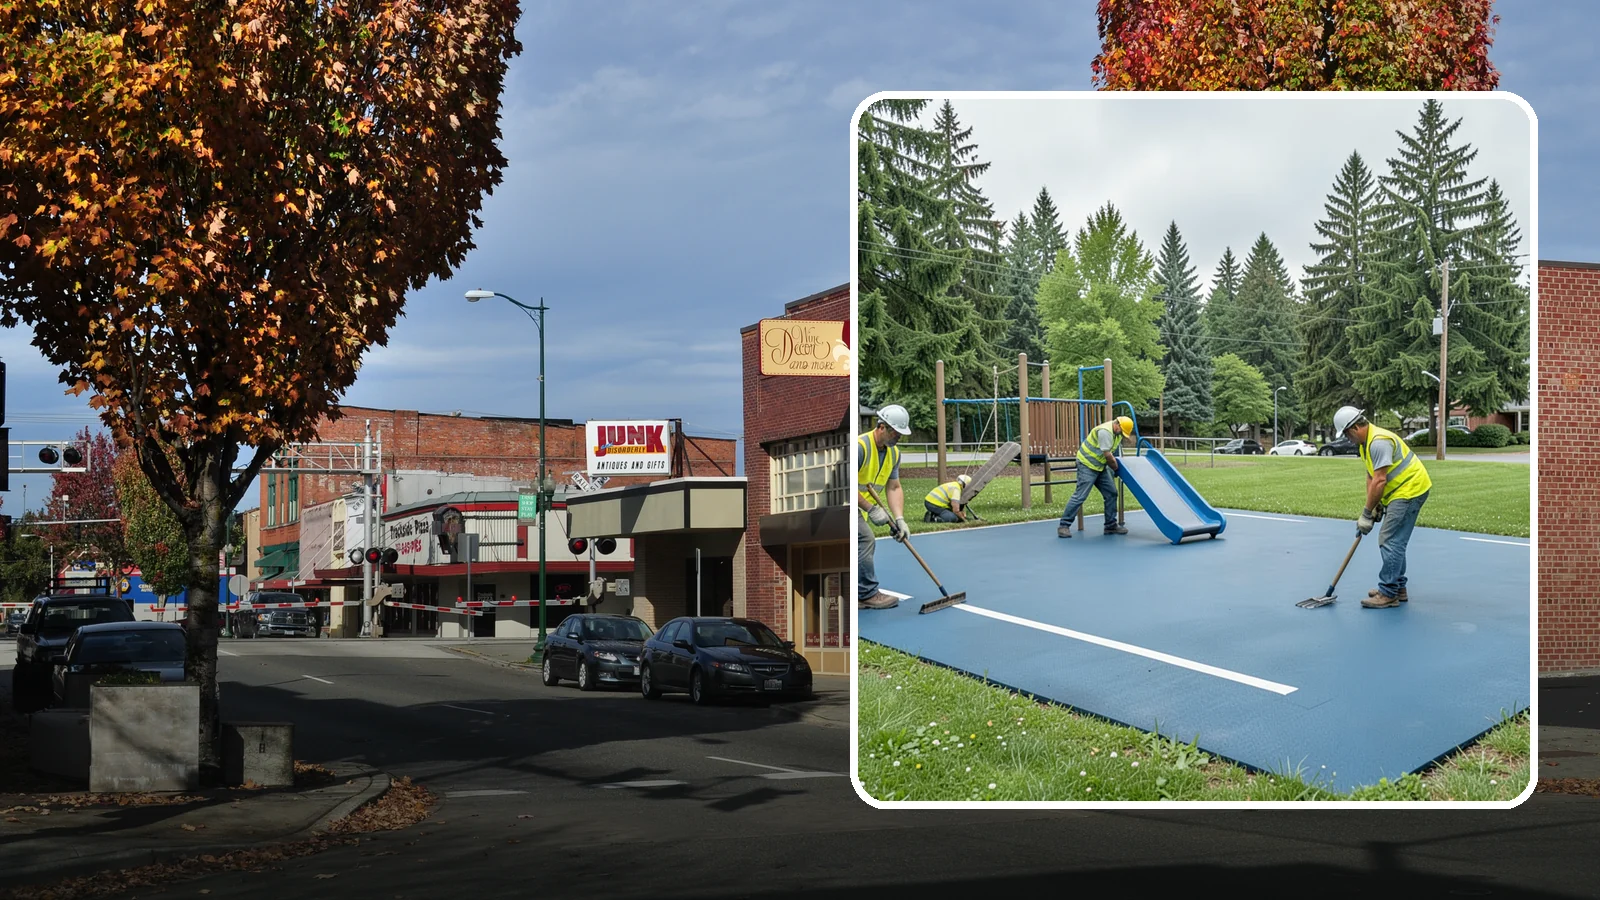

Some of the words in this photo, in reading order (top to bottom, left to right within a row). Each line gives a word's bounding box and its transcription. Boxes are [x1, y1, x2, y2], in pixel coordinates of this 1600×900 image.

[596, 425, 665, 457] JUNK
[607, 446, 645, 454] DISORDERLY
[597, 461, 628, 470] ANTIQUES
[631, 461, 643, 469] AND
[647, 460, 665, 469] GIFTS
[390, 522, 413, 539] Trackside
[415, 519, 429, 535] Pizza
